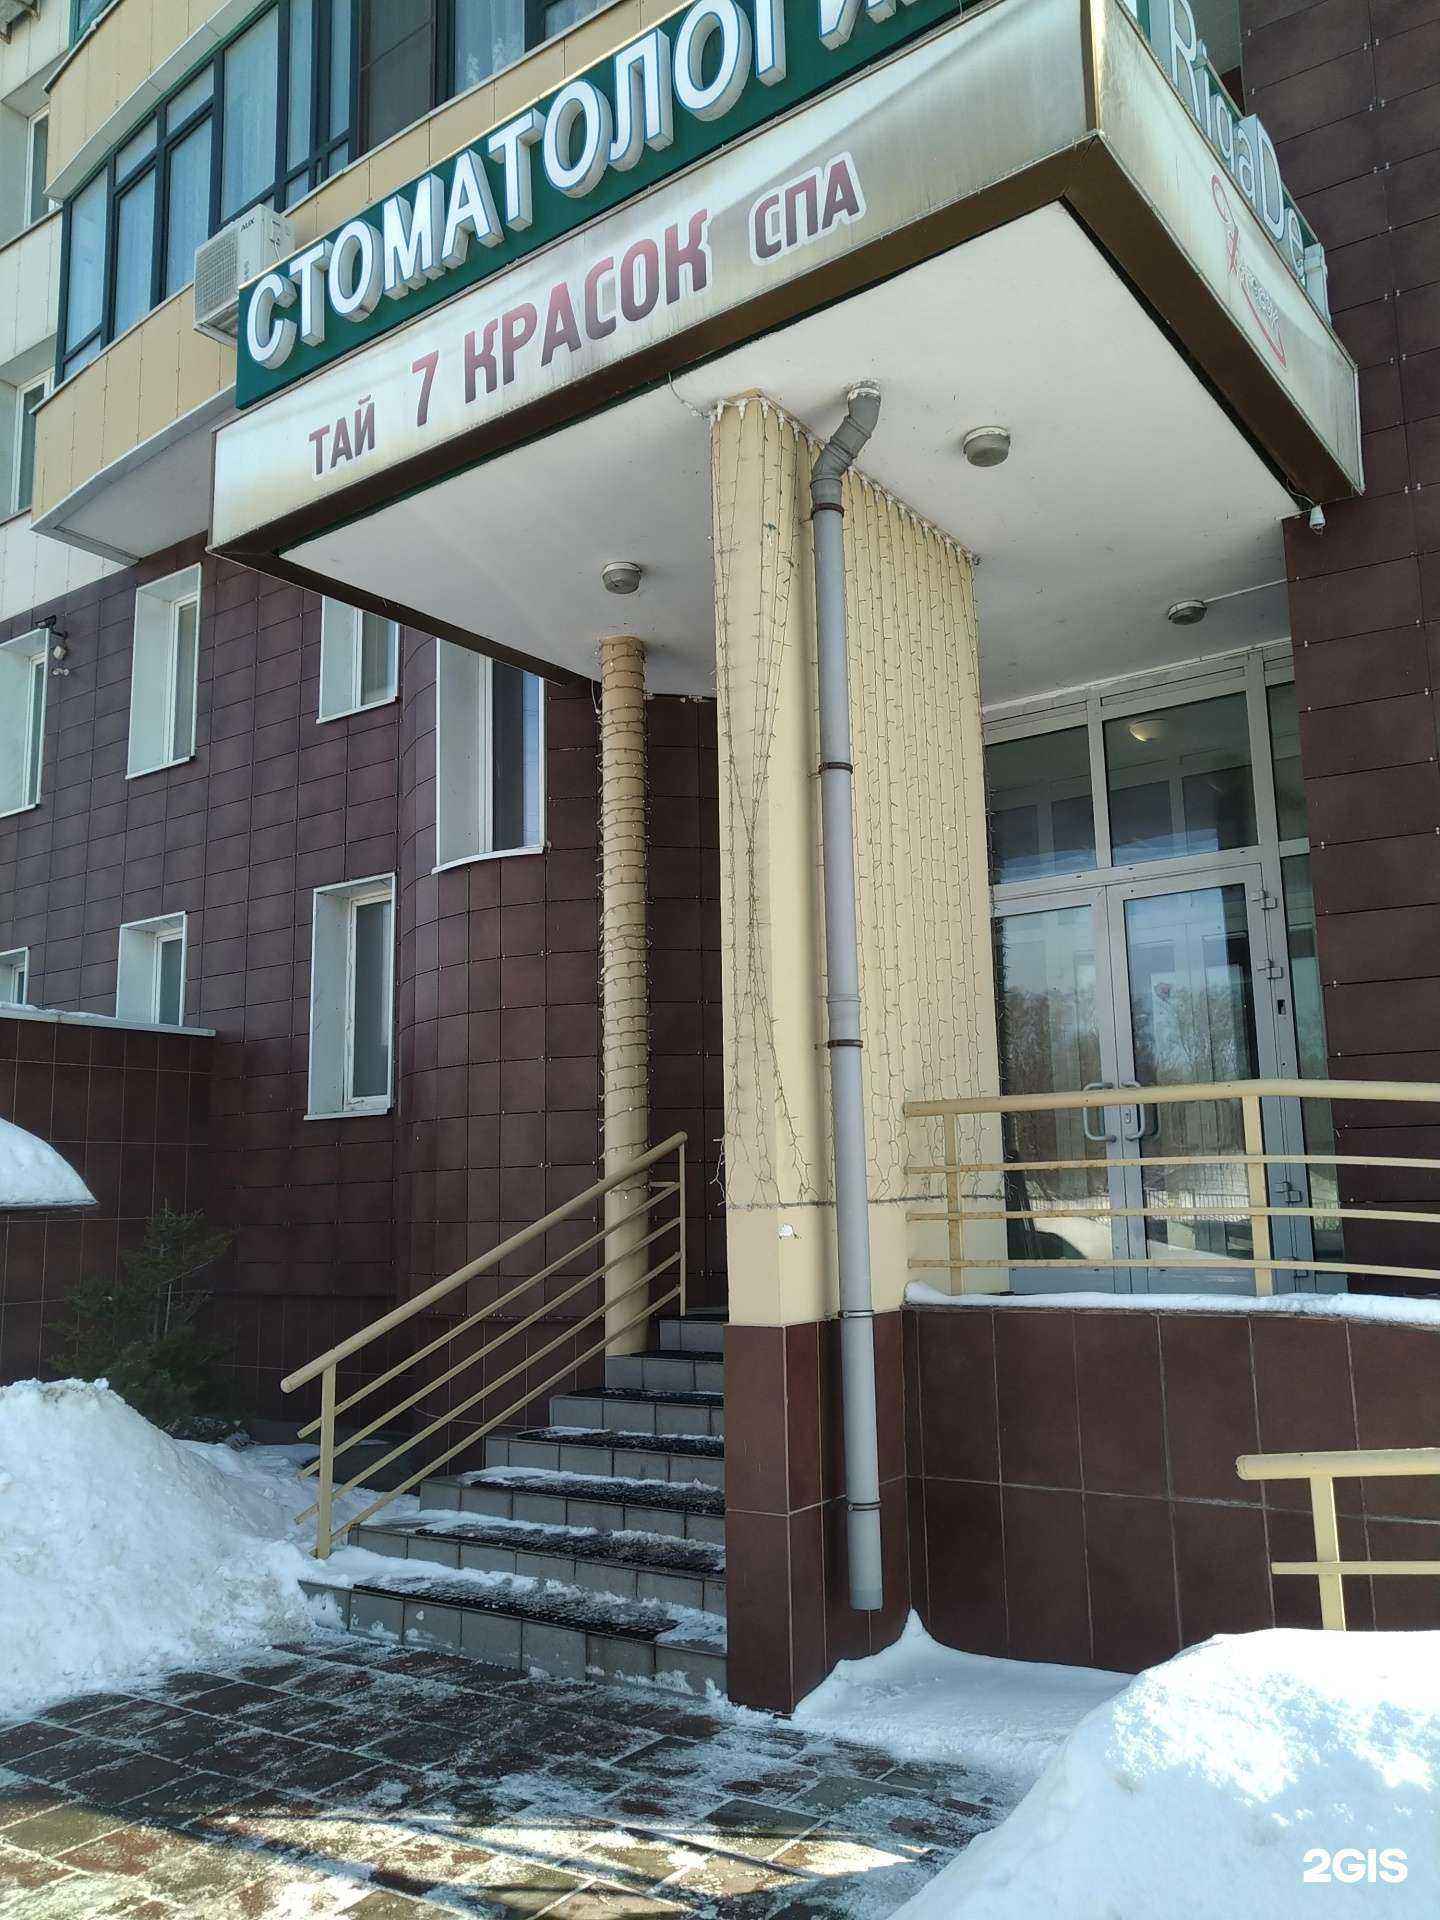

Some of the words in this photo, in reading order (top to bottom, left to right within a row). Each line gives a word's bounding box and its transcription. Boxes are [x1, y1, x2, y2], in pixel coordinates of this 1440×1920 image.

[247, 0, 918, 369] СТОМАТОЛО
[309, 394, 376, 476] ТАЙ
[411, 350, 440, 428] 7
[464, 208, 708, 404] КРАСОК
[754, 159, 860, 259] СПА
